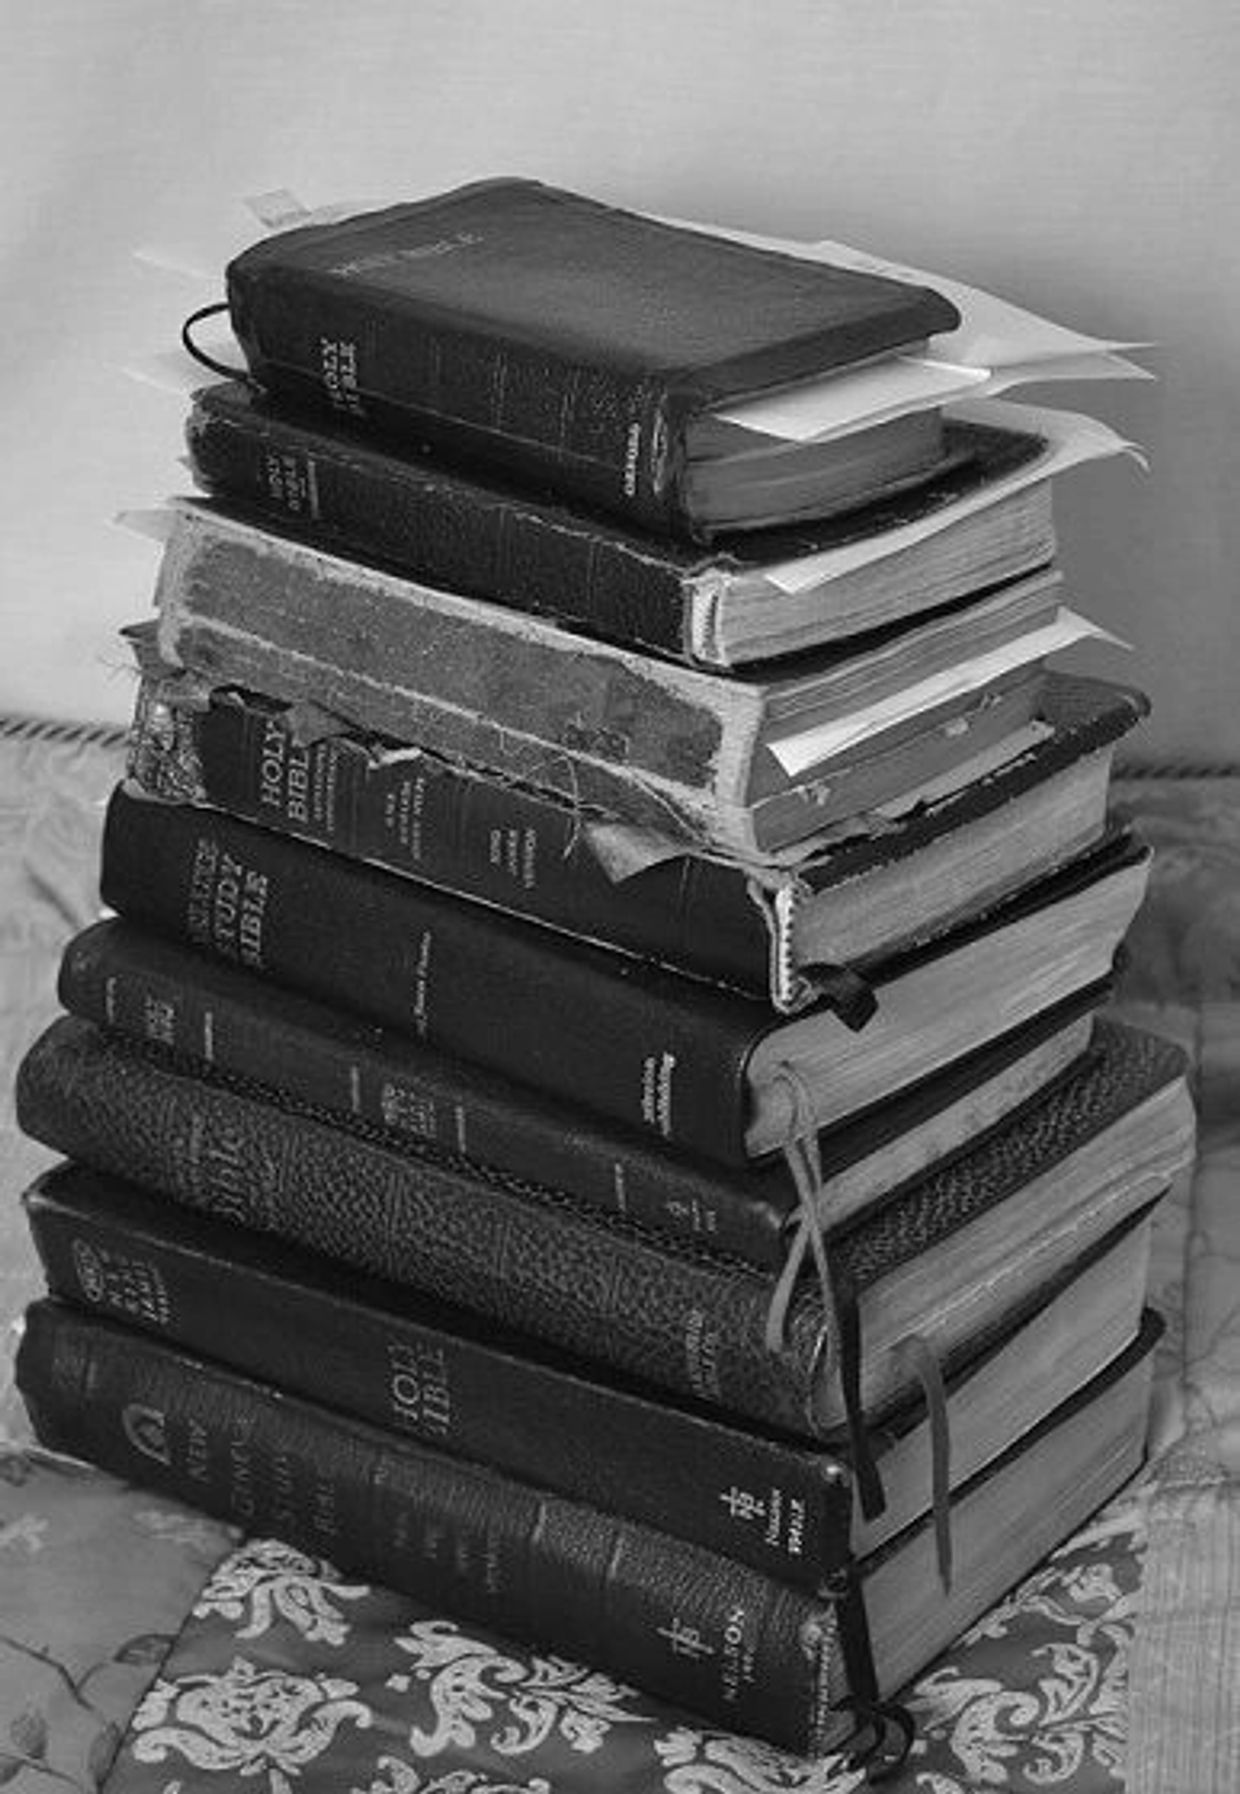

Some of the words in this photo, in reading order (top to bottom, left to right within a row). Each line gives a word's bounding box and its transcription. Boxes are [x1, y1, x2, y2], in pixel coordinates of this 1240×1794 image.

[260, 720, 286, 807] HOLY
[287, 750, 309, 824] BIBL
[214, 853, 242, 959] STUDY
[239, 871, 268, 971] BIBLE
[721, 1604, 746, 1701] NELSON
